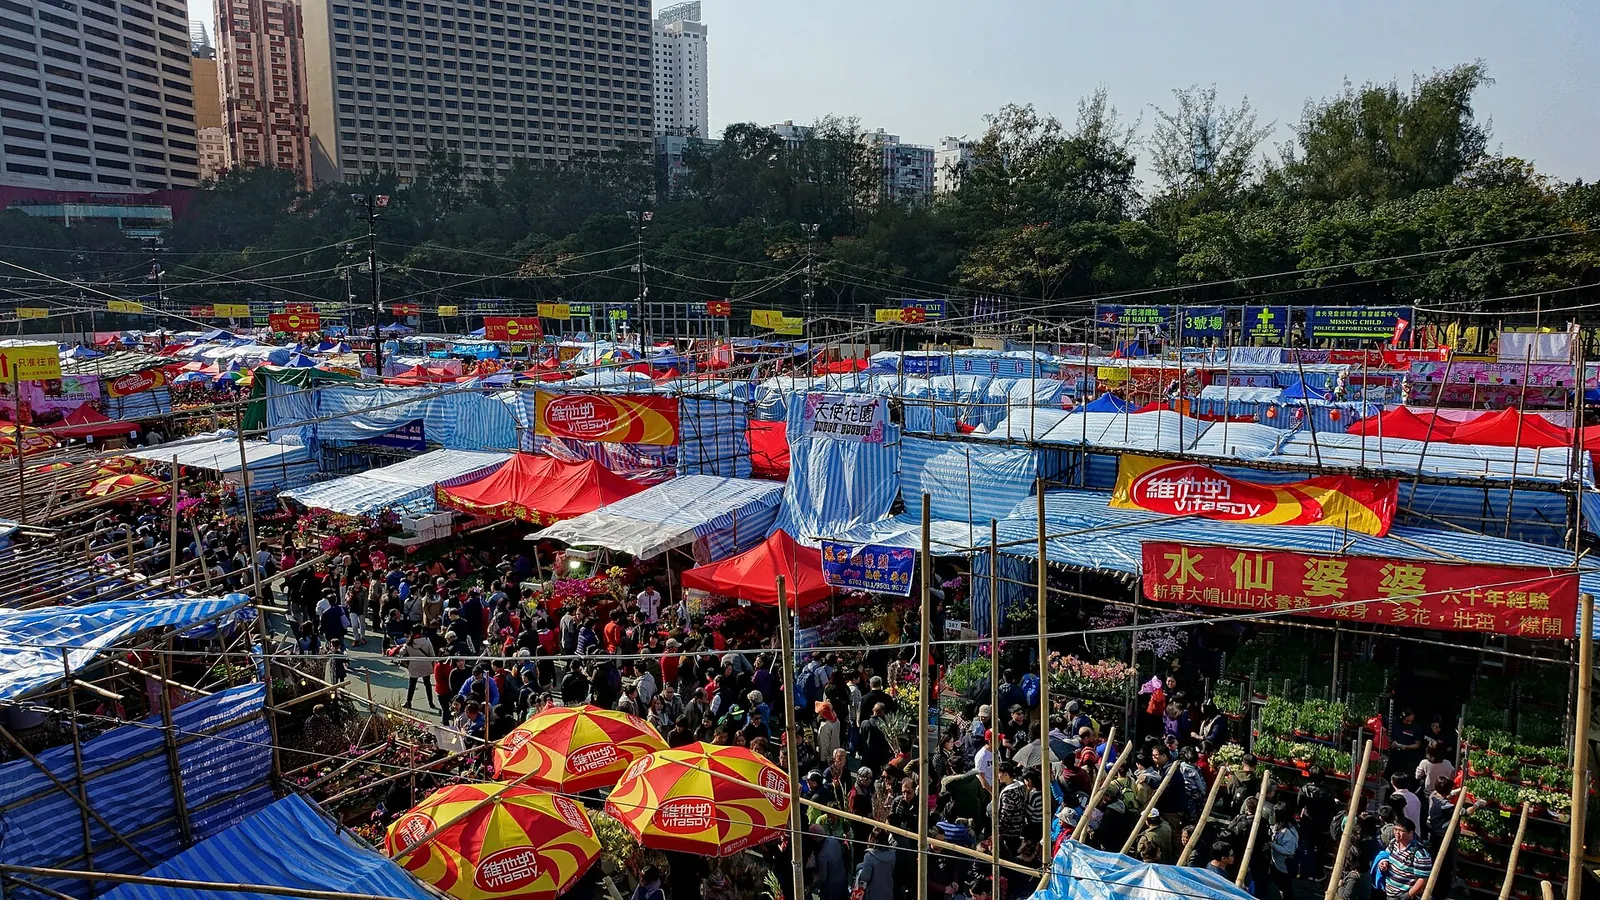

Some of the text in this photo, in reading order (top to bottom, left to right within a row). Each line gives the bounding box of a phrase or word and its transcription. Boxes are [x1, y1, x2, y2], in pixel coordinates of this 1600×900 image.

[1185, 316, 1223, 330] 3號場
[18, 357, 56, 367] 只准往前
[552, 402, 595, 422] 維他奶
[814, 402, 874, 422] 天使花園
[567, 418, 611, 432] vitasoy
[1146, 477, 1231, 500] 維他奶
[1174, 498, 1258, 517] vitasoy
[1163, 547, 1427, 606] 水仙婆婆
[1441, 586, 1550, 610] 六十年經驗
[572, 746, 616, 766] 維他奶
[662, 803, 712, 818] 維他奶
[662, 818, 710, 828] vitasoy
[482, 851, 536, 878] 維他奶
[485, 865, 538, 888] vitasoy
